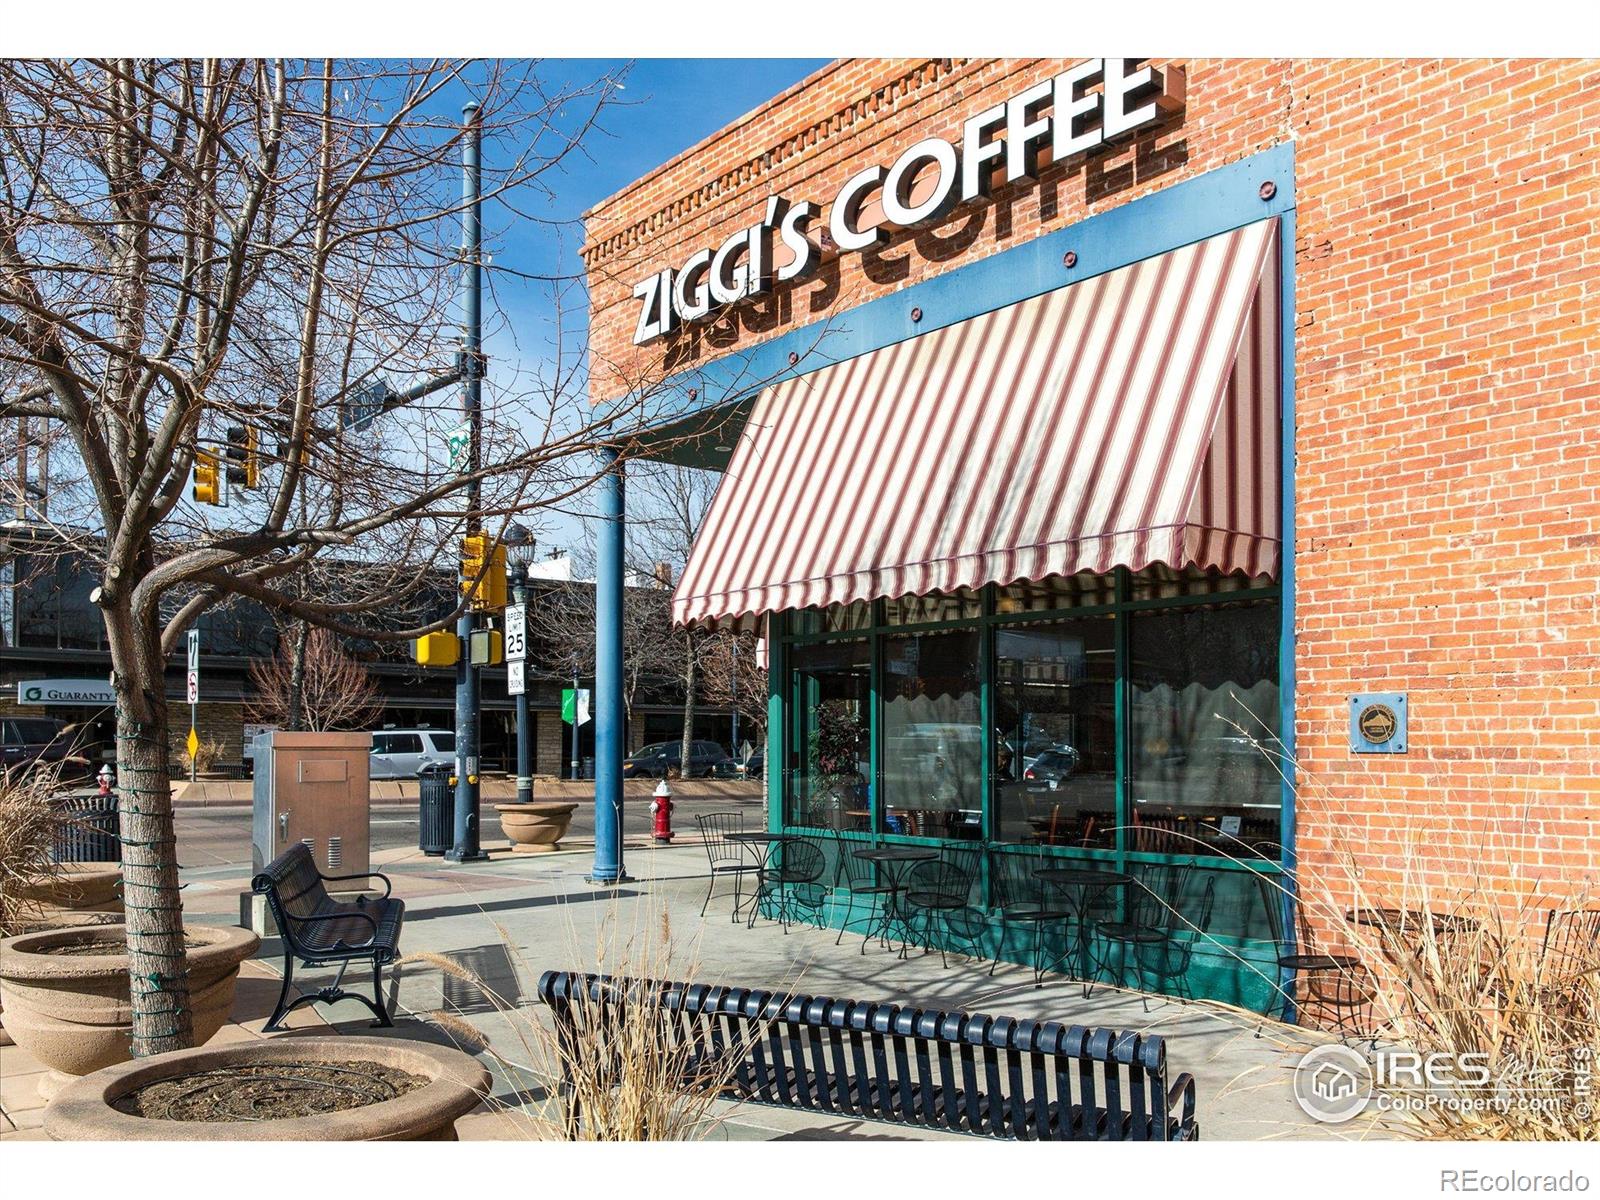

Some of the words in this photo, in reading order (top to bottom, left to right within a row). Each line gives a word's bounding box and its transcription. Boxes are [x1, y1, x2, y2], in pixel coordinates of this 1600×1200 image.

[633, 196, 809, 346] ZIGGI'S
[829, 58, 1157, 250] COFFEE
[507, 611, 523, 622] SPEED
[508, 622, 522, 633] LIMIT
[508, 633, 524, 654] 25
[47, 689, 112, 700] GUARANTY
